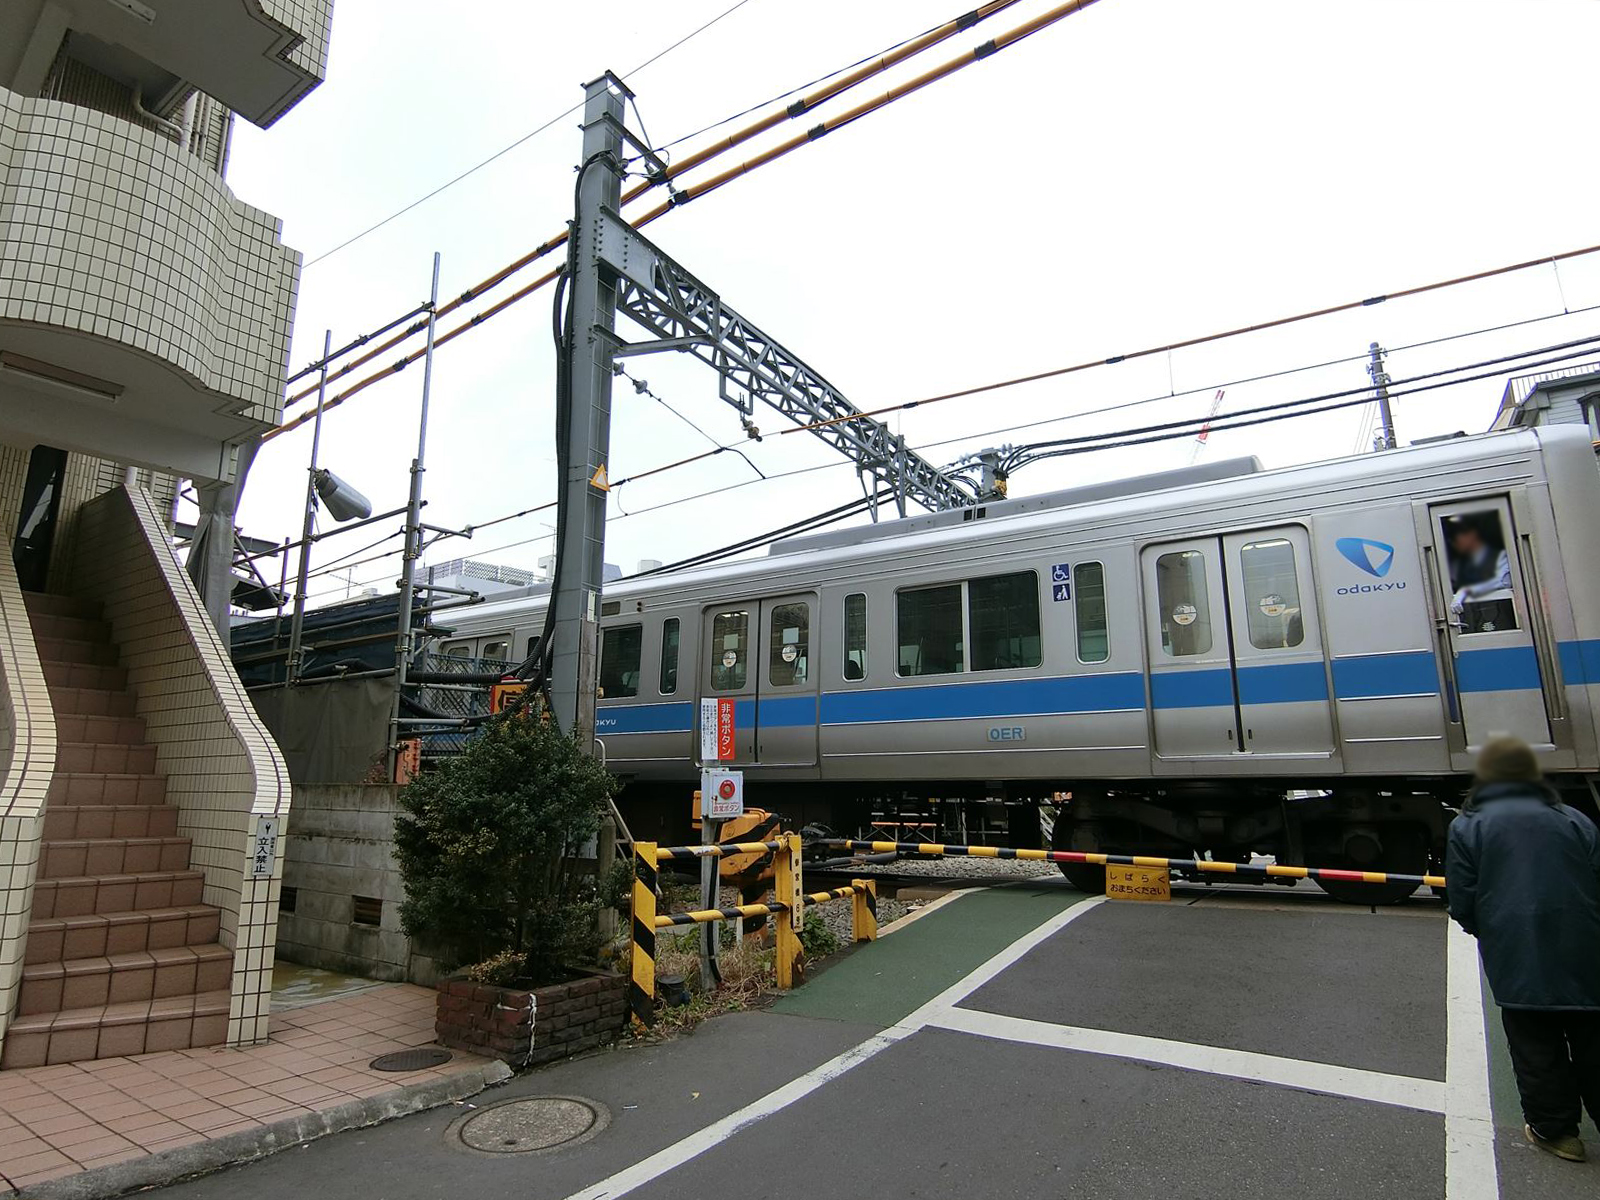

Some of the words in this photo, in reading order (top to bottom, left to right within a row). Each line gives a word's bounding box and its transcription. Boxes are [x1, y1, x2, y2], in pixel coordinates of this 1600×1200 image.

[721, 703, 731, 756] 非常ボタン
[990, 727, 1023, 740] OER
[254, 837, 269, 873] 立入禁止
[1110, 872, 1165, 883] しばらく
[1110, 884, 1166, 895] おまちください
